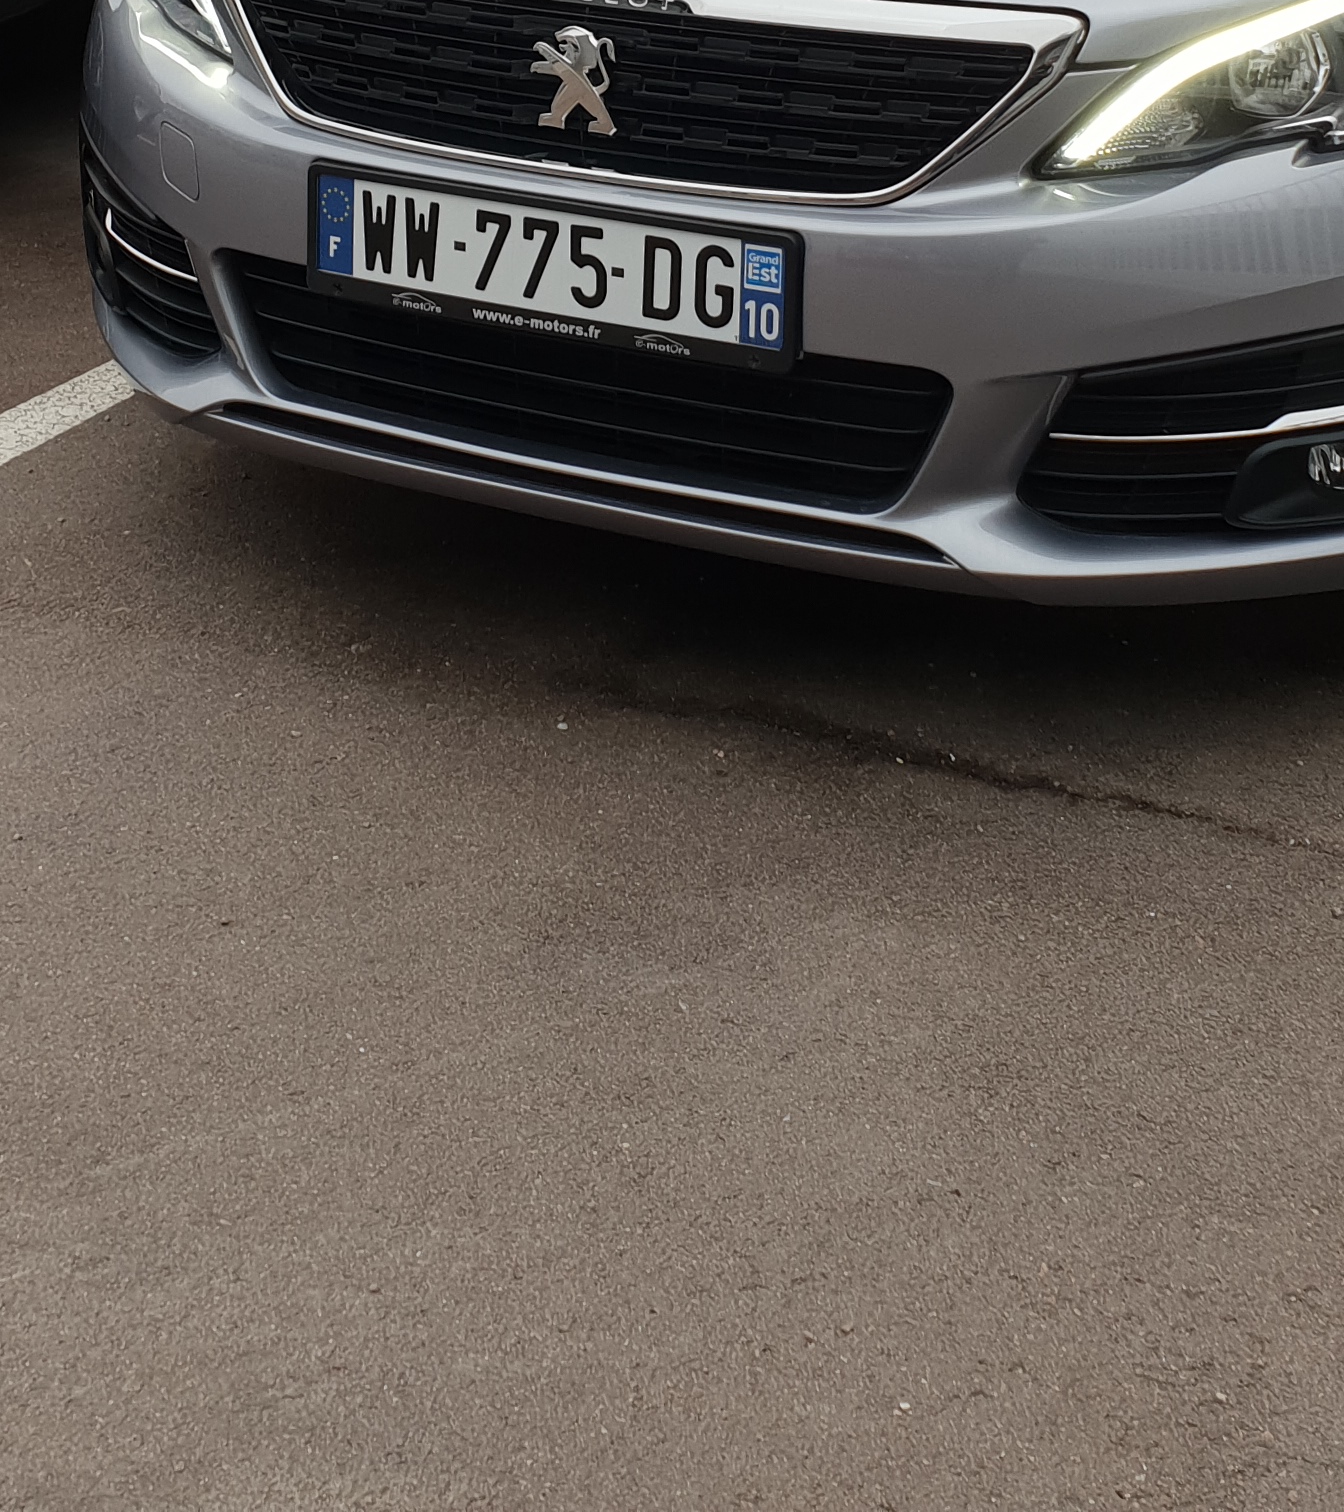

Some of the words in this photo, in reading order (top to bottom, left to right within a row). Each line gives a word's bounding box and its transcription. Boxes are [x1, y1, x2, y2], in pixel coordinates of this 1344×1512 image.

[329, 235, 341, 258] F
[362, 189, 736, 329] WW-775-DG
[748, 252, 779, 265] Grand
[747, 263, 779, 284] Est
[472, 308, 602, 340] www.e-motors.fr
[744, 299, 780, 341] 10
